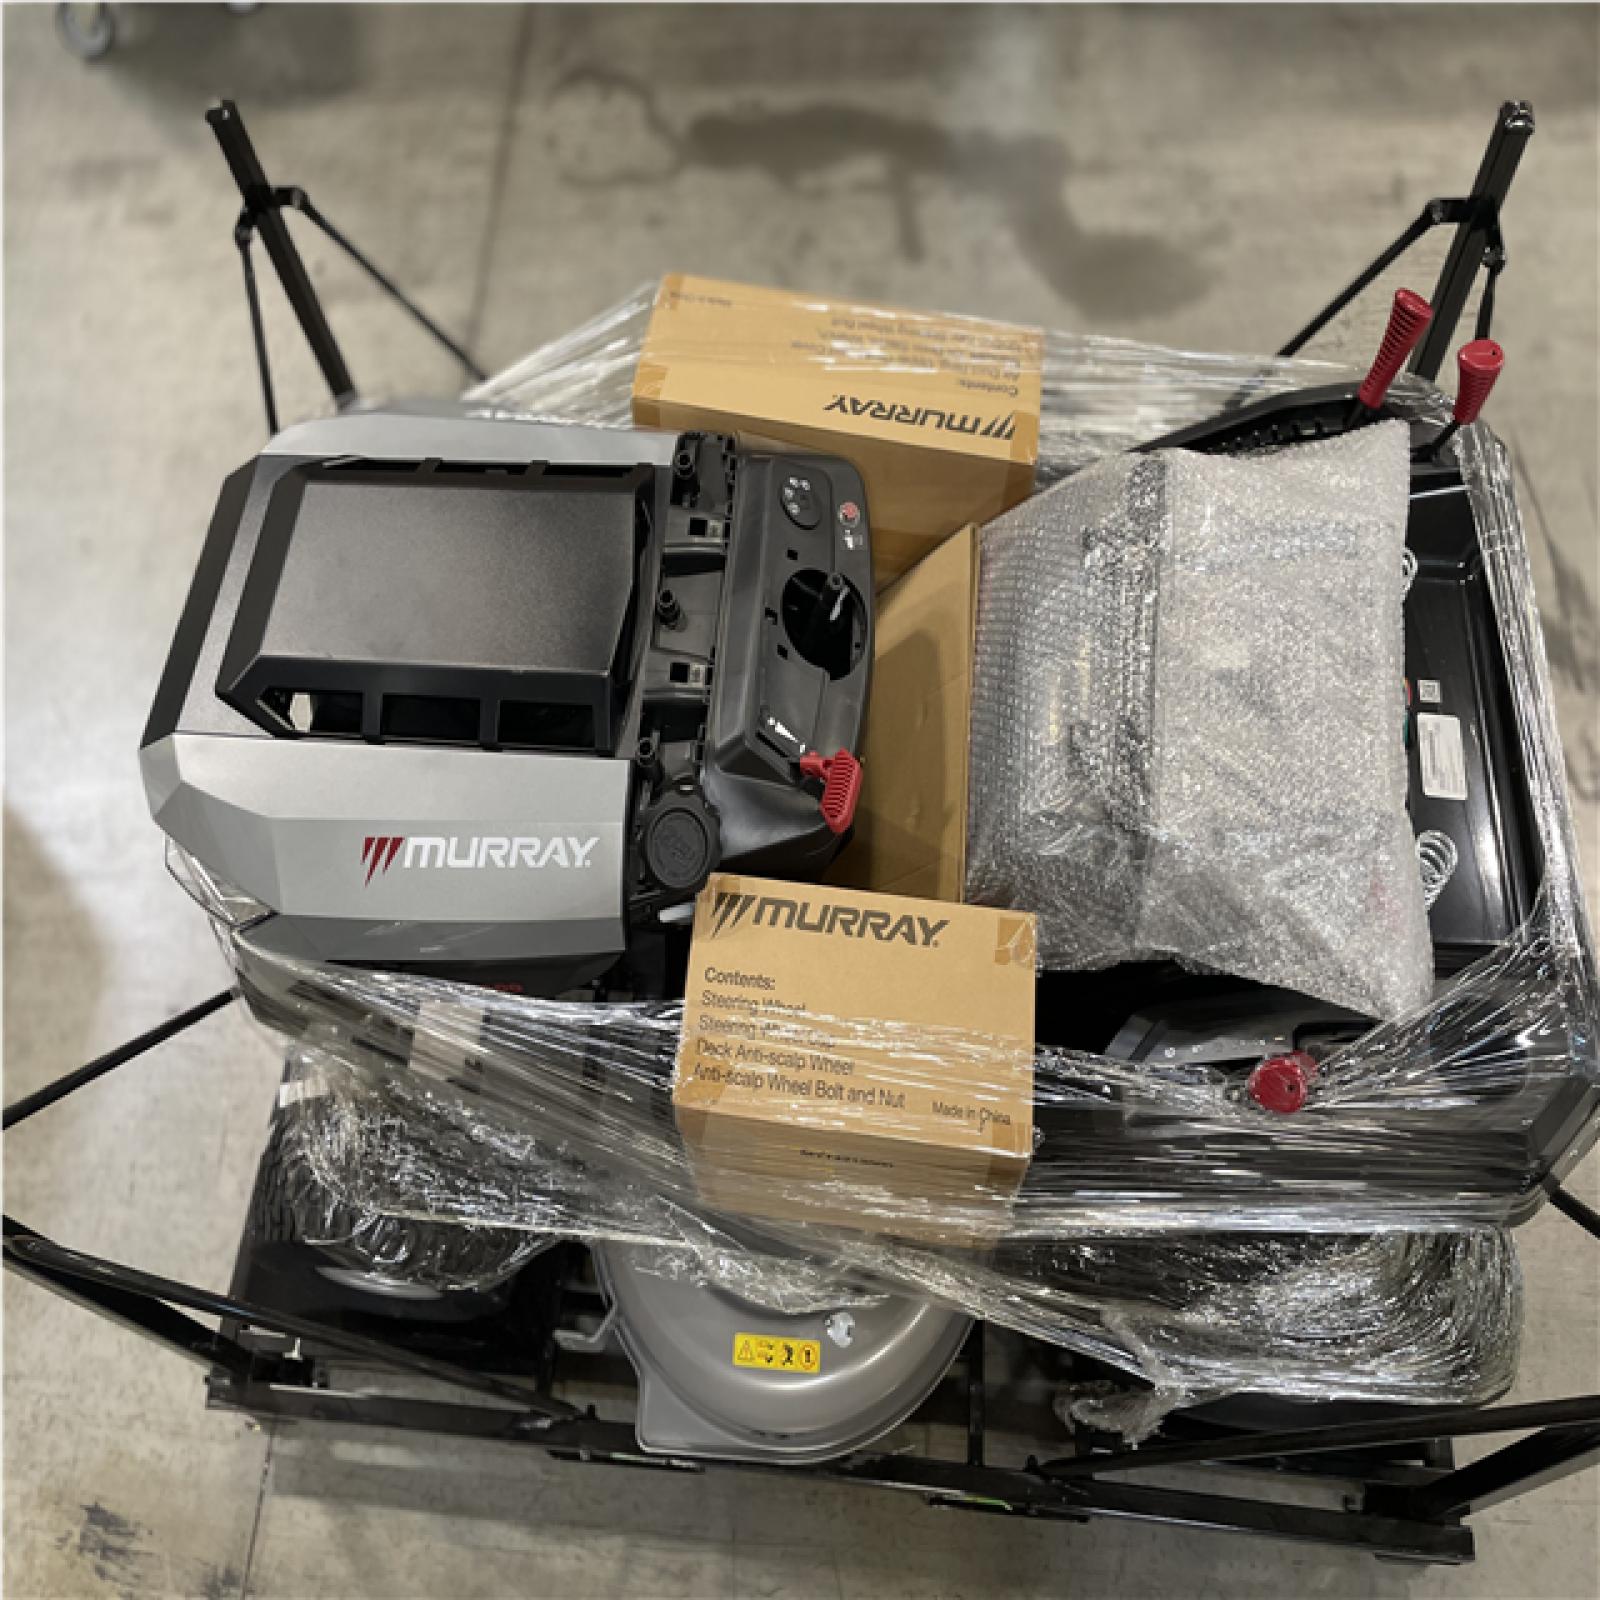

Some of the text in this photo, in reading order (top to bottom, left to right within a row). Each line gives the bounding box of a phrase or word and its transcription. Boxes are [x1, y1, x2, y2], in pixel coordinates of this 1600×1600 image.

[824, 395, 982, 435] MURRAY
[403, 836, 600, 869] MURRAY
[753, 897, 949, 948] MURRAY
[704, 966, 776, 991] Contents:
[702, 989, 758, 1016] Steering
[695, 1062, 906, 1109] Anti-scalp Wheel Bolt and Nut
[932, 1100, 963, 1118] Made
[967, 1103, 976, 1119] in
